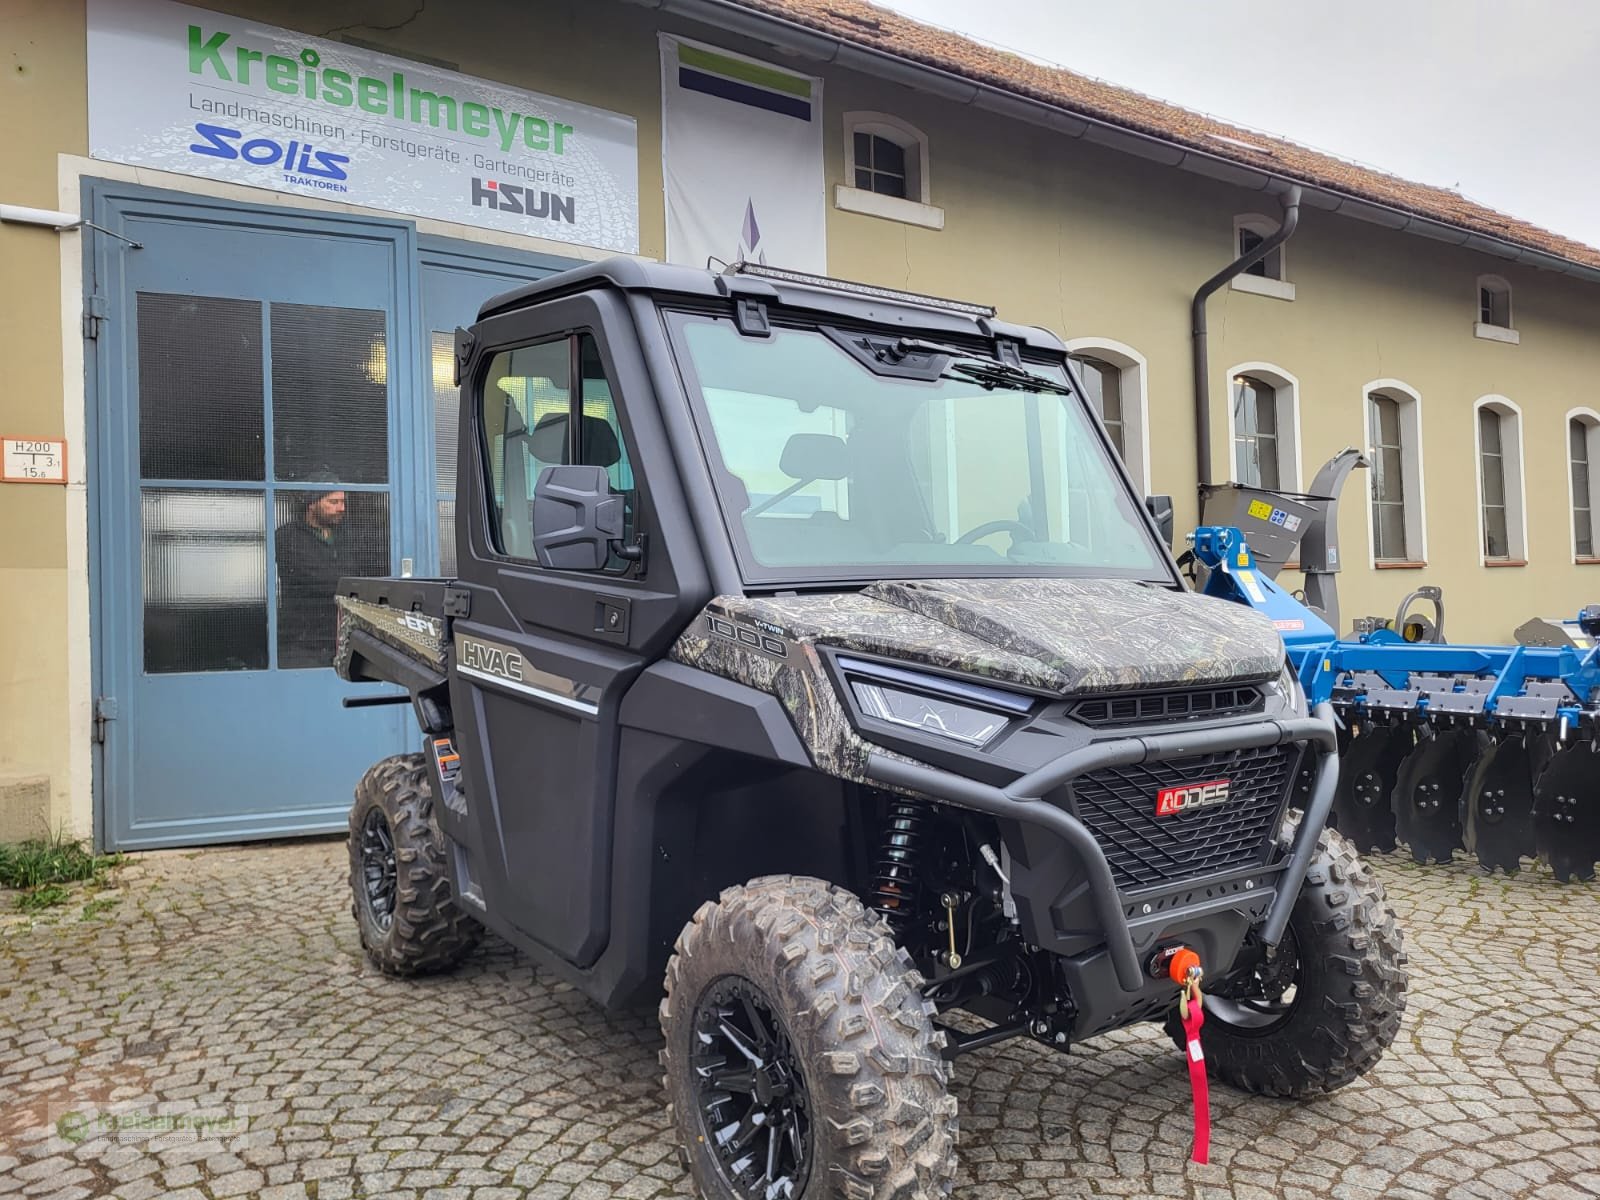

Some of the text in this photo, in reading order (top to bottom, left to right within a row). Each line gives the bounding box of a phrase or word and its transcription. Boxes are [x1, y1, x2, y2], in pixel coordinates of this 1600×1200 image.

[187, 24, 573, 155] Kreiselmeyer
[189, 93, 574, 187] Landmaschinen Forstgeräte Gartengeräte
[284, 174, 347, 193] TRAKTOREN
[705, 614, 788, 659] 1000
[754, 619, 784, 635] V-TWIN
[463, 640, 523, 681] HVAC
[1160, 782, 1230, 813] AODES
